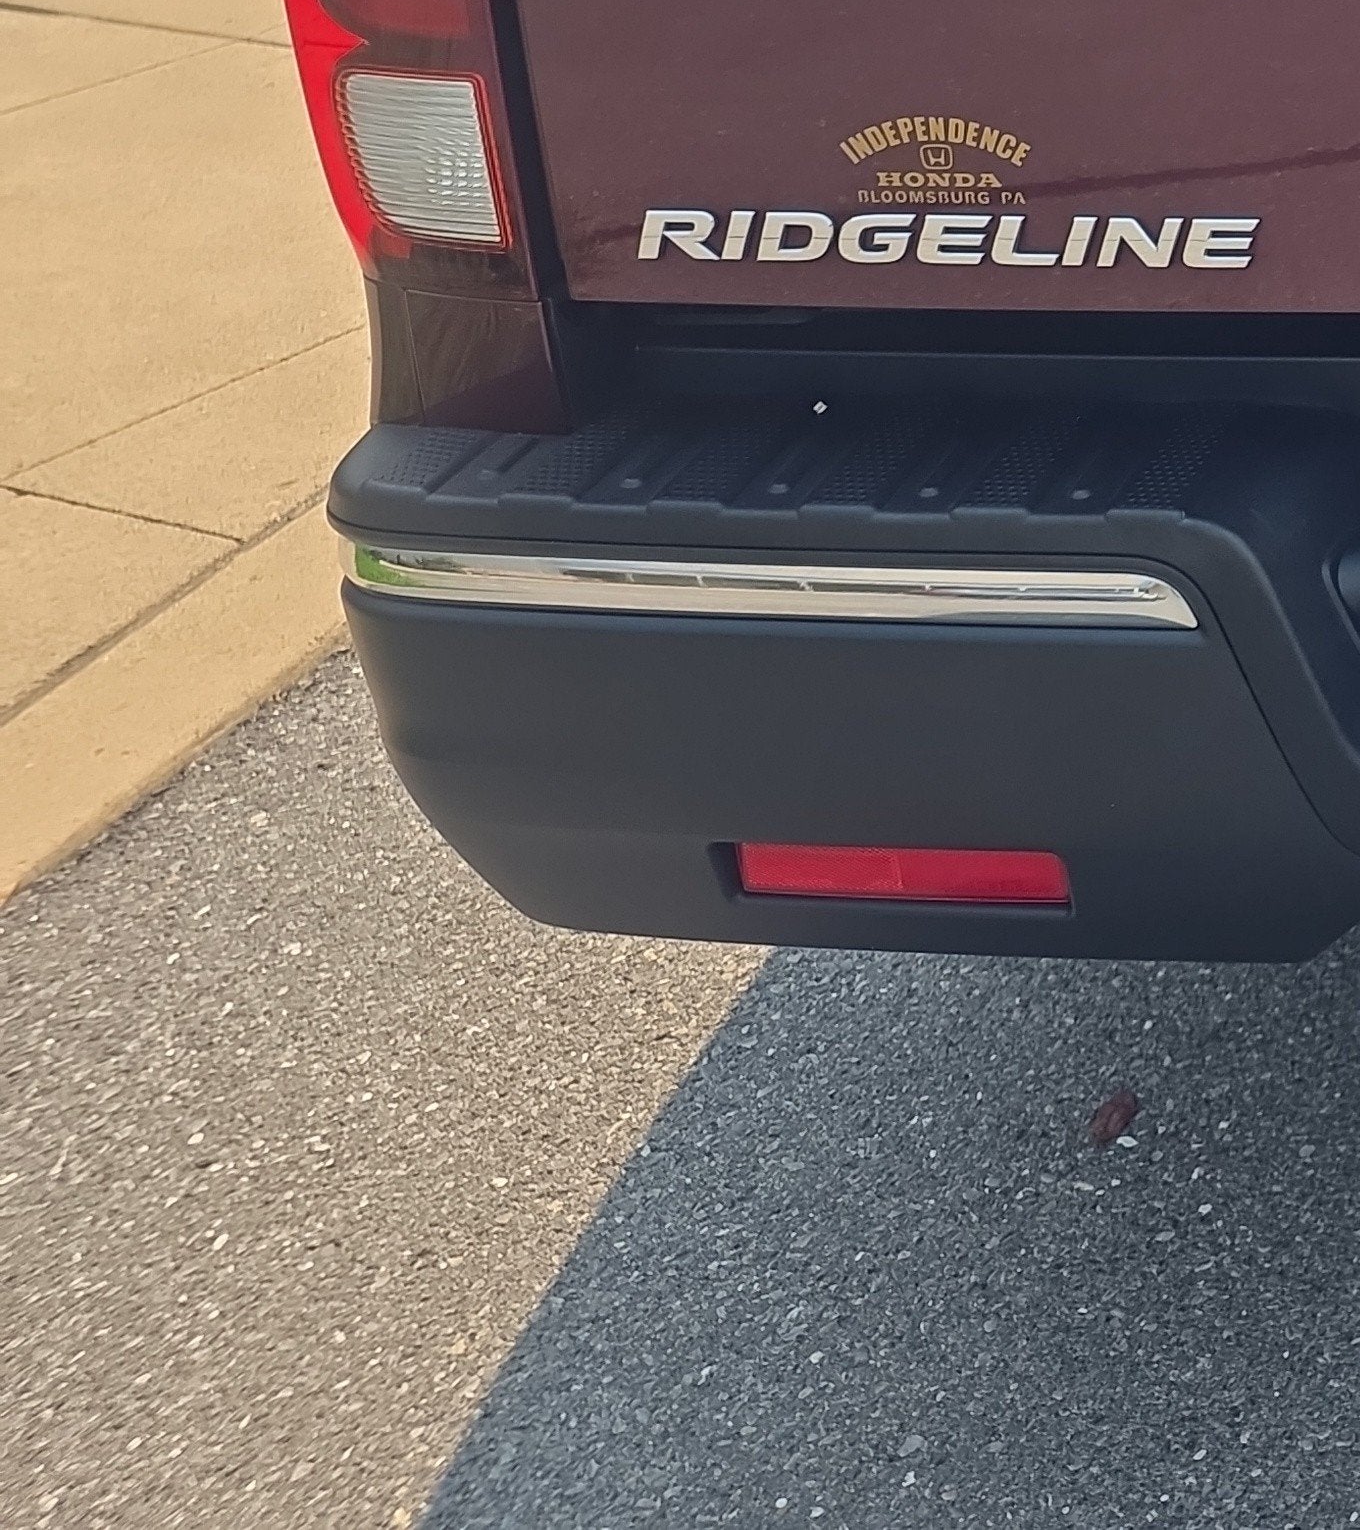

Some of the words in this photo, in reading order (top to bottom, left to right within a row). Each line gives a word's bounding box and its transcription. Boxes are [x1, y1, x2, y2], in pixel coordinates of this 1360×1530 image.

[838, 116, 1032, 168] INDEPENDENCE
[876, 171, 1003, 188] HONDA
[857, 189, 990, 205] BLOOMSBURG
[1001, 191, 1026, 205] PA
[637, 209, 1261, 269] RIDGELINE
